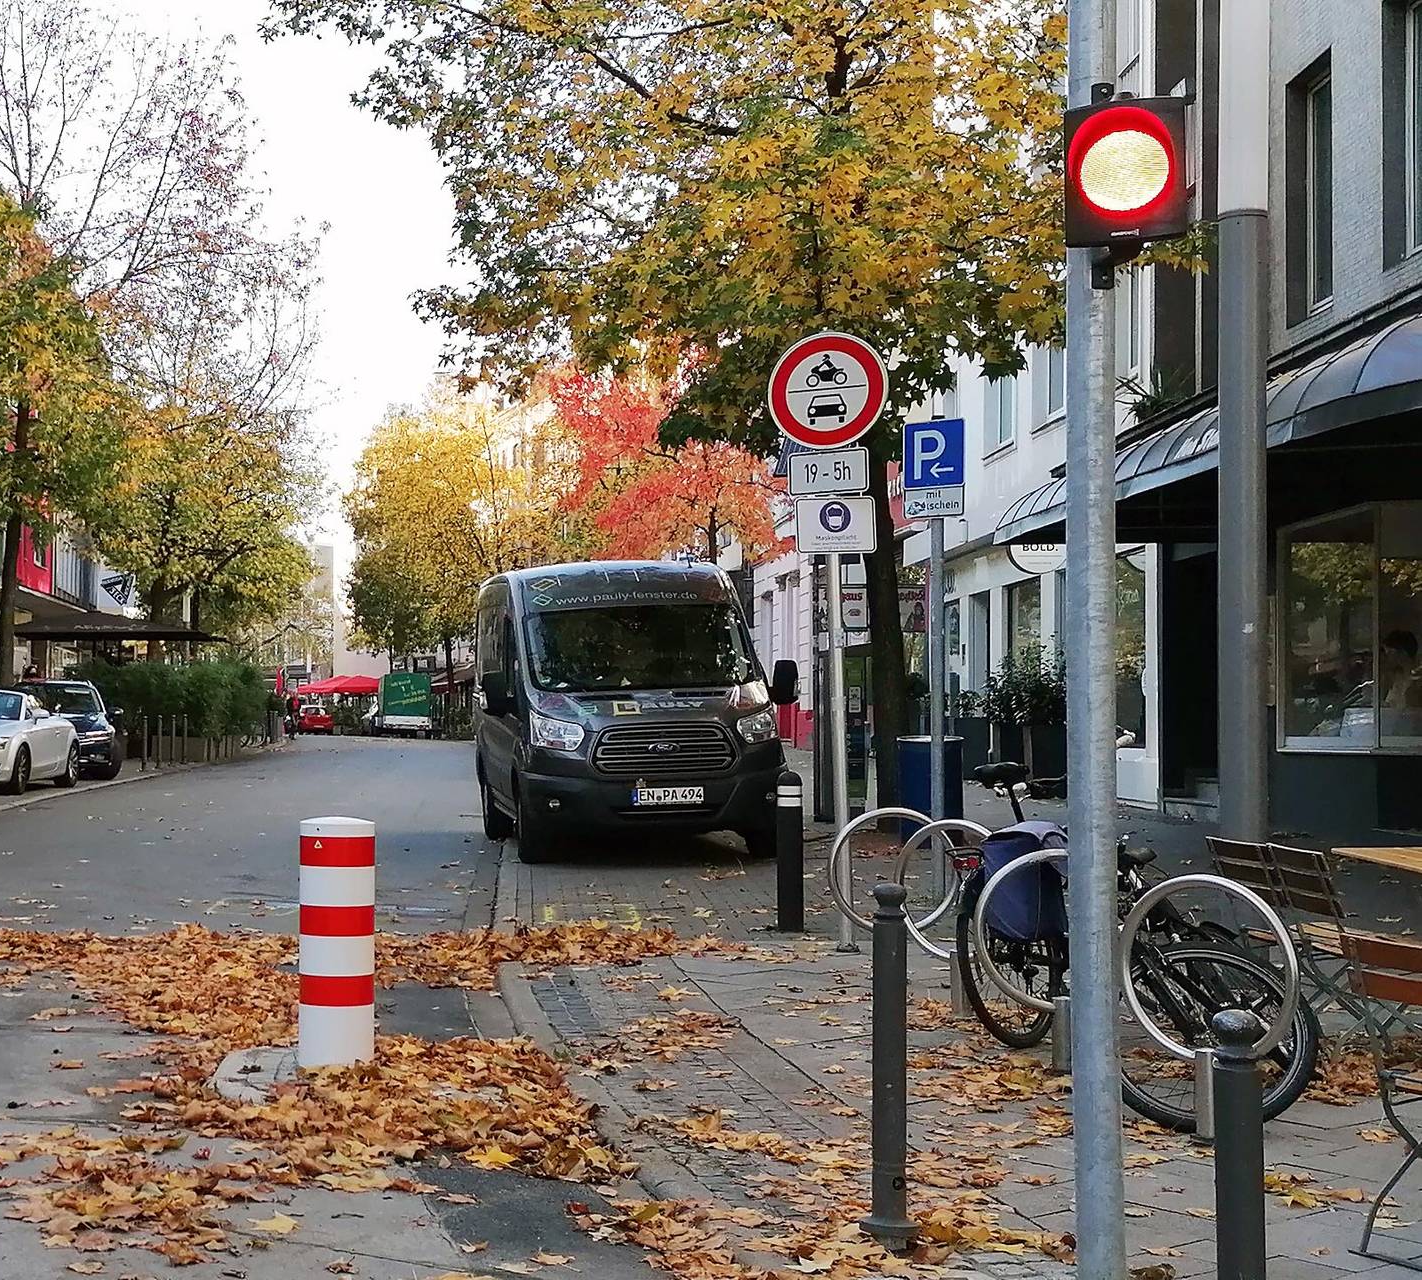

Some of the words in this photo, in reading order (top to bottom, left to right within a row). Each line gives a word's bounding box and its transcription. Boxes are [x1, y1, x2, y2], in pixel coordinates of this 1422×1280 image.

[914, 430, 946, 480] P
[804, 463, 818, 484] 19
[833, 461, 852, 481] 5h
[925, 490, 942, 499] mit
[555, 590, 698, 606] www.pauly-fenster.de
[639, 790, 655, 801] EN
[663, 789, 677, 801] PA
[681, 788, 703, 800] 494
